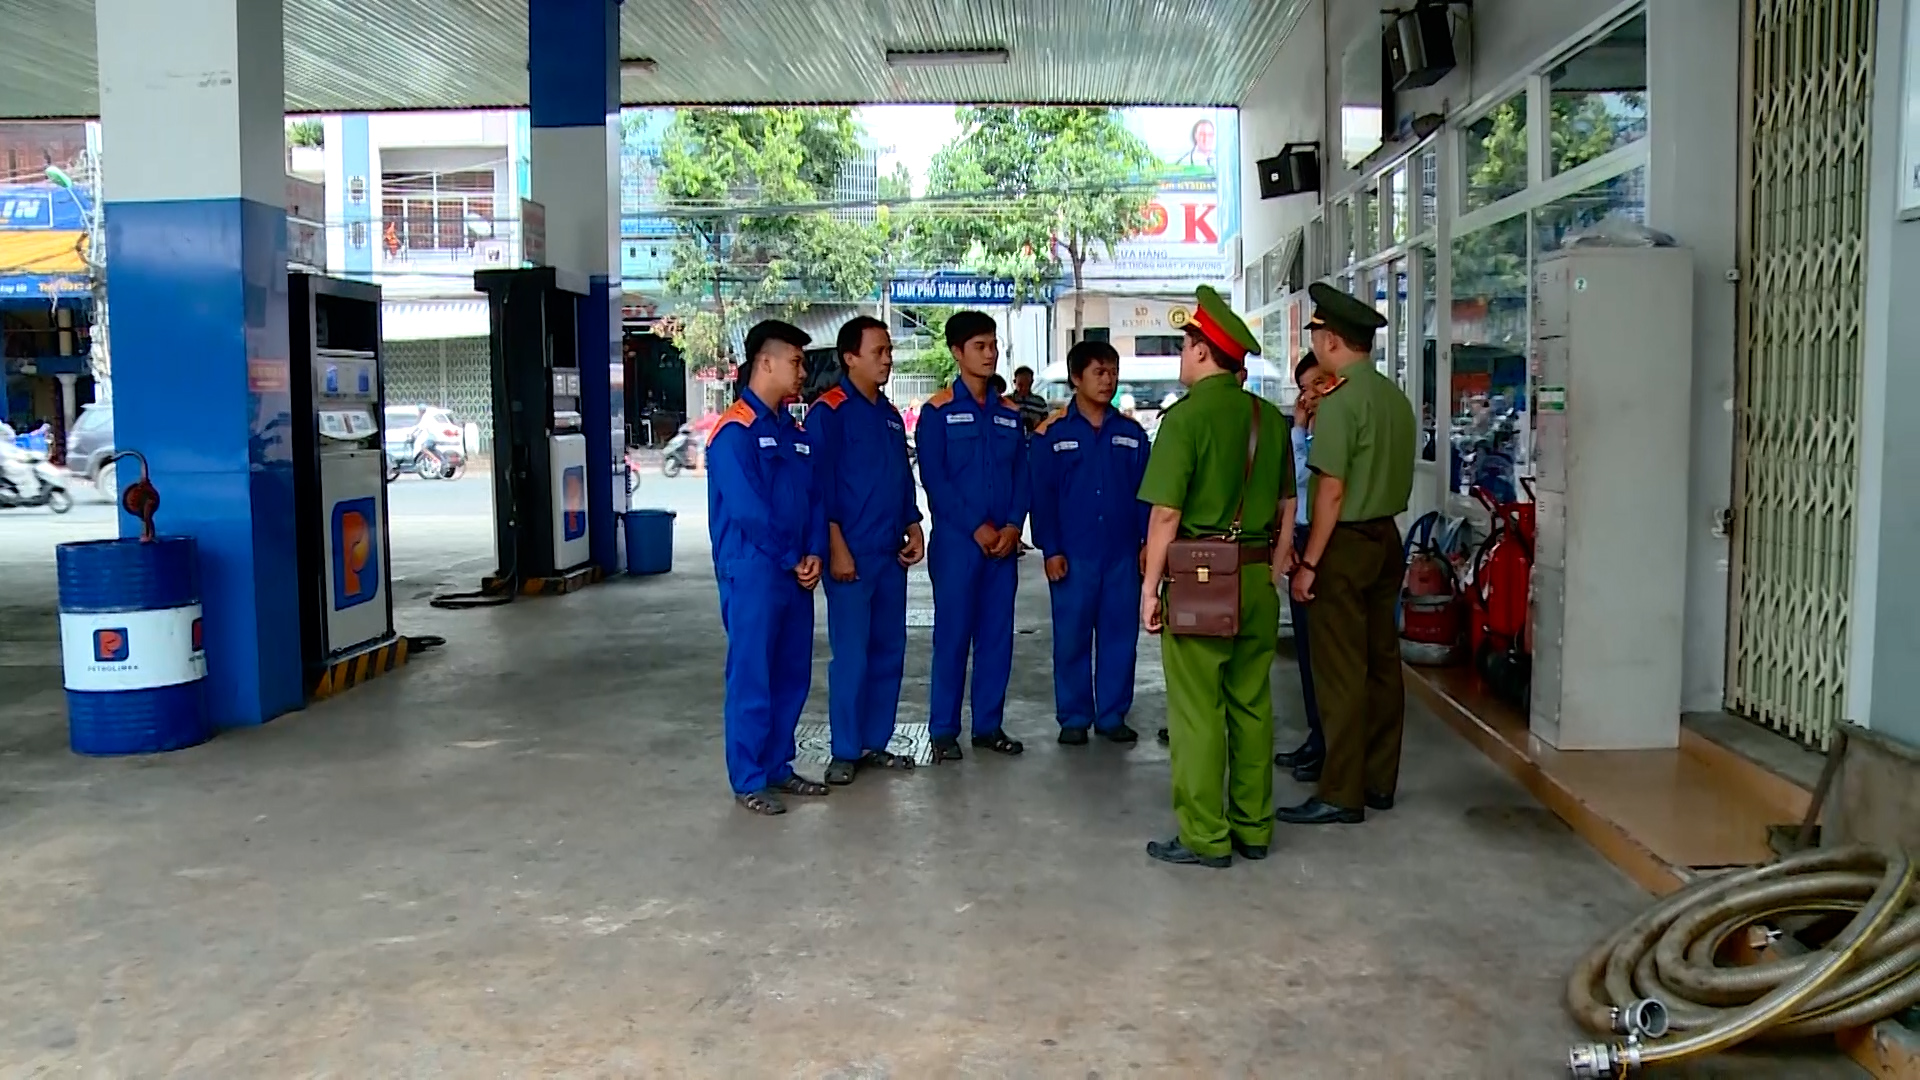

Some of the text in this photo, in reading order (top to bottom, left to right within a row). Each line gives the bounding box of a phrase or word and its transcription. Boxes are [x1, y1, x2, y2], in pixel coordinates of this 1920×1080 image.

[0, 199, 41, 218] IN
[1180, 203, 1218, 243] K
[917, 279, 937, 298] PHỐ
[958, 280, 977, 298] HÓA
[979, 280, 992, 298] SỐ
[994, 283, 1005, 298] 10
